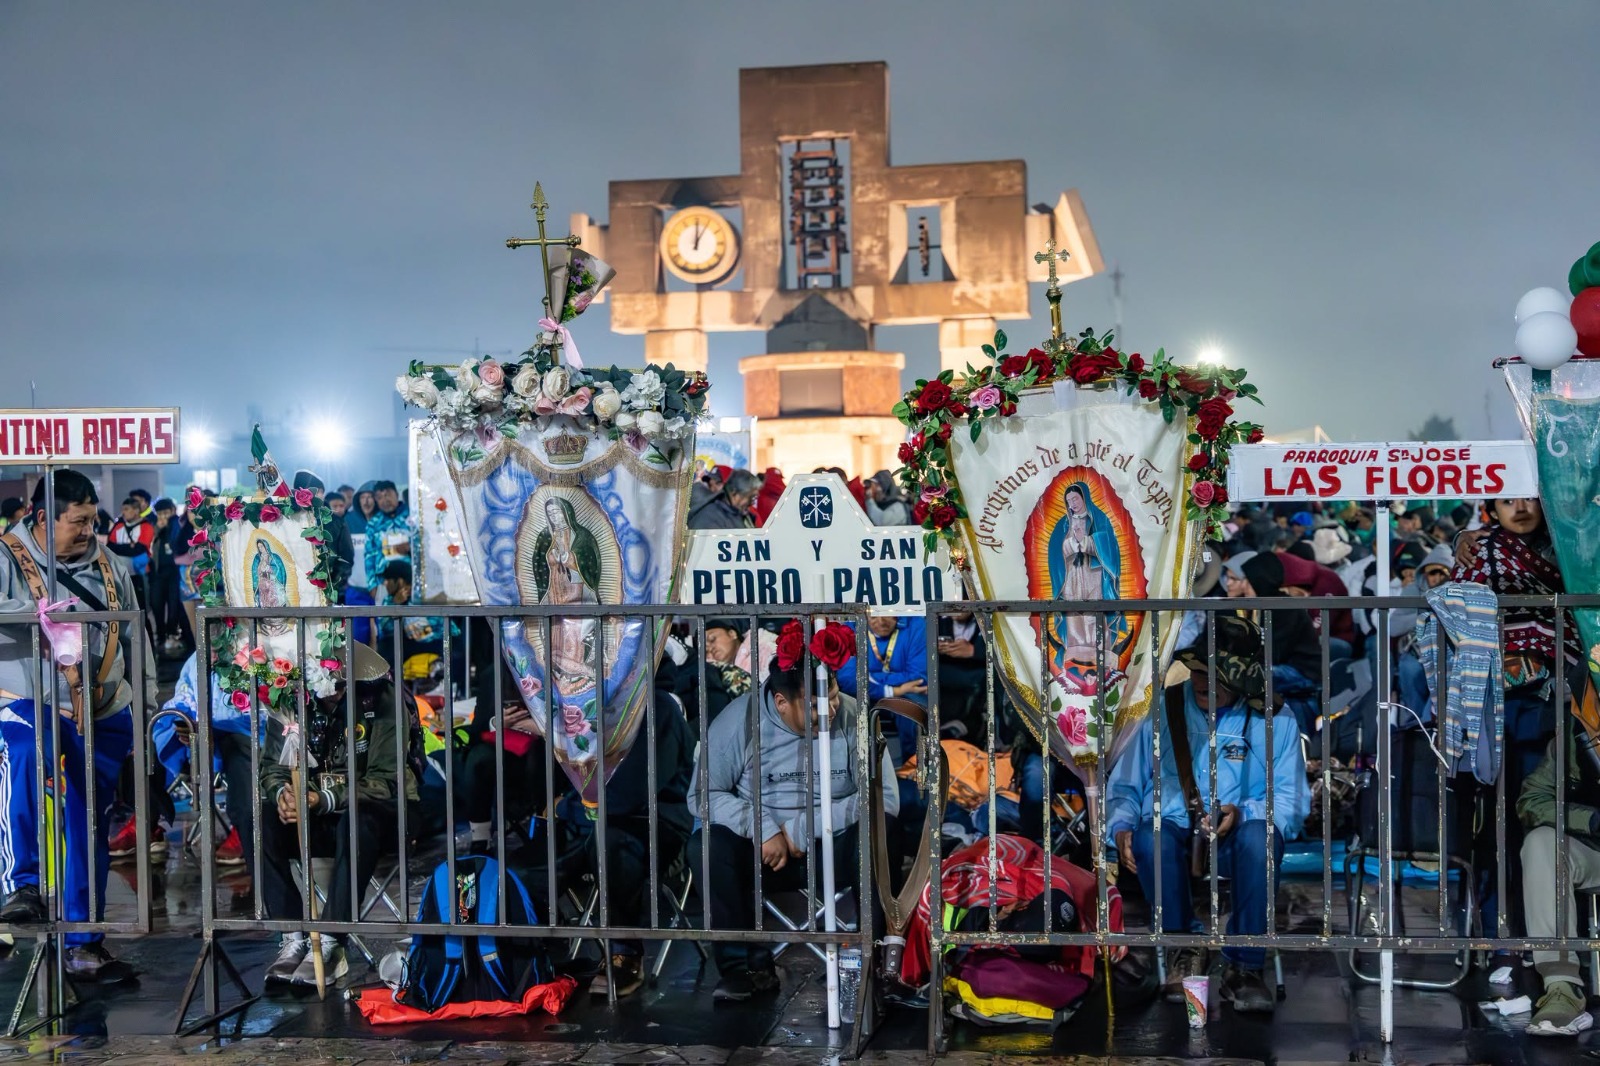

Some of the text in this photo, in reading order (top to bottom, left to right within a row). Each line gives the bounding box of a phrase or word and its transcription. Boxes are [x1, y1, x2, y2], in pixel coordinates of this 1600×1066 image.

[82, 417, 173, 455] ROSAS
[1036, 445, 1061, 469] de
[1068, 441, 1078, 460] a
[1112, 453, 1135, 473] al
[1282, 448, 1379, 465] PARROQUIA
[1263, 463, 1507, 498] LAS FLORES
[10, 541, 38, 580] SAN
[717, 537, 917, 562] SAN Y SAN
[693, 566, 943, 606] PEDRO PABLO
